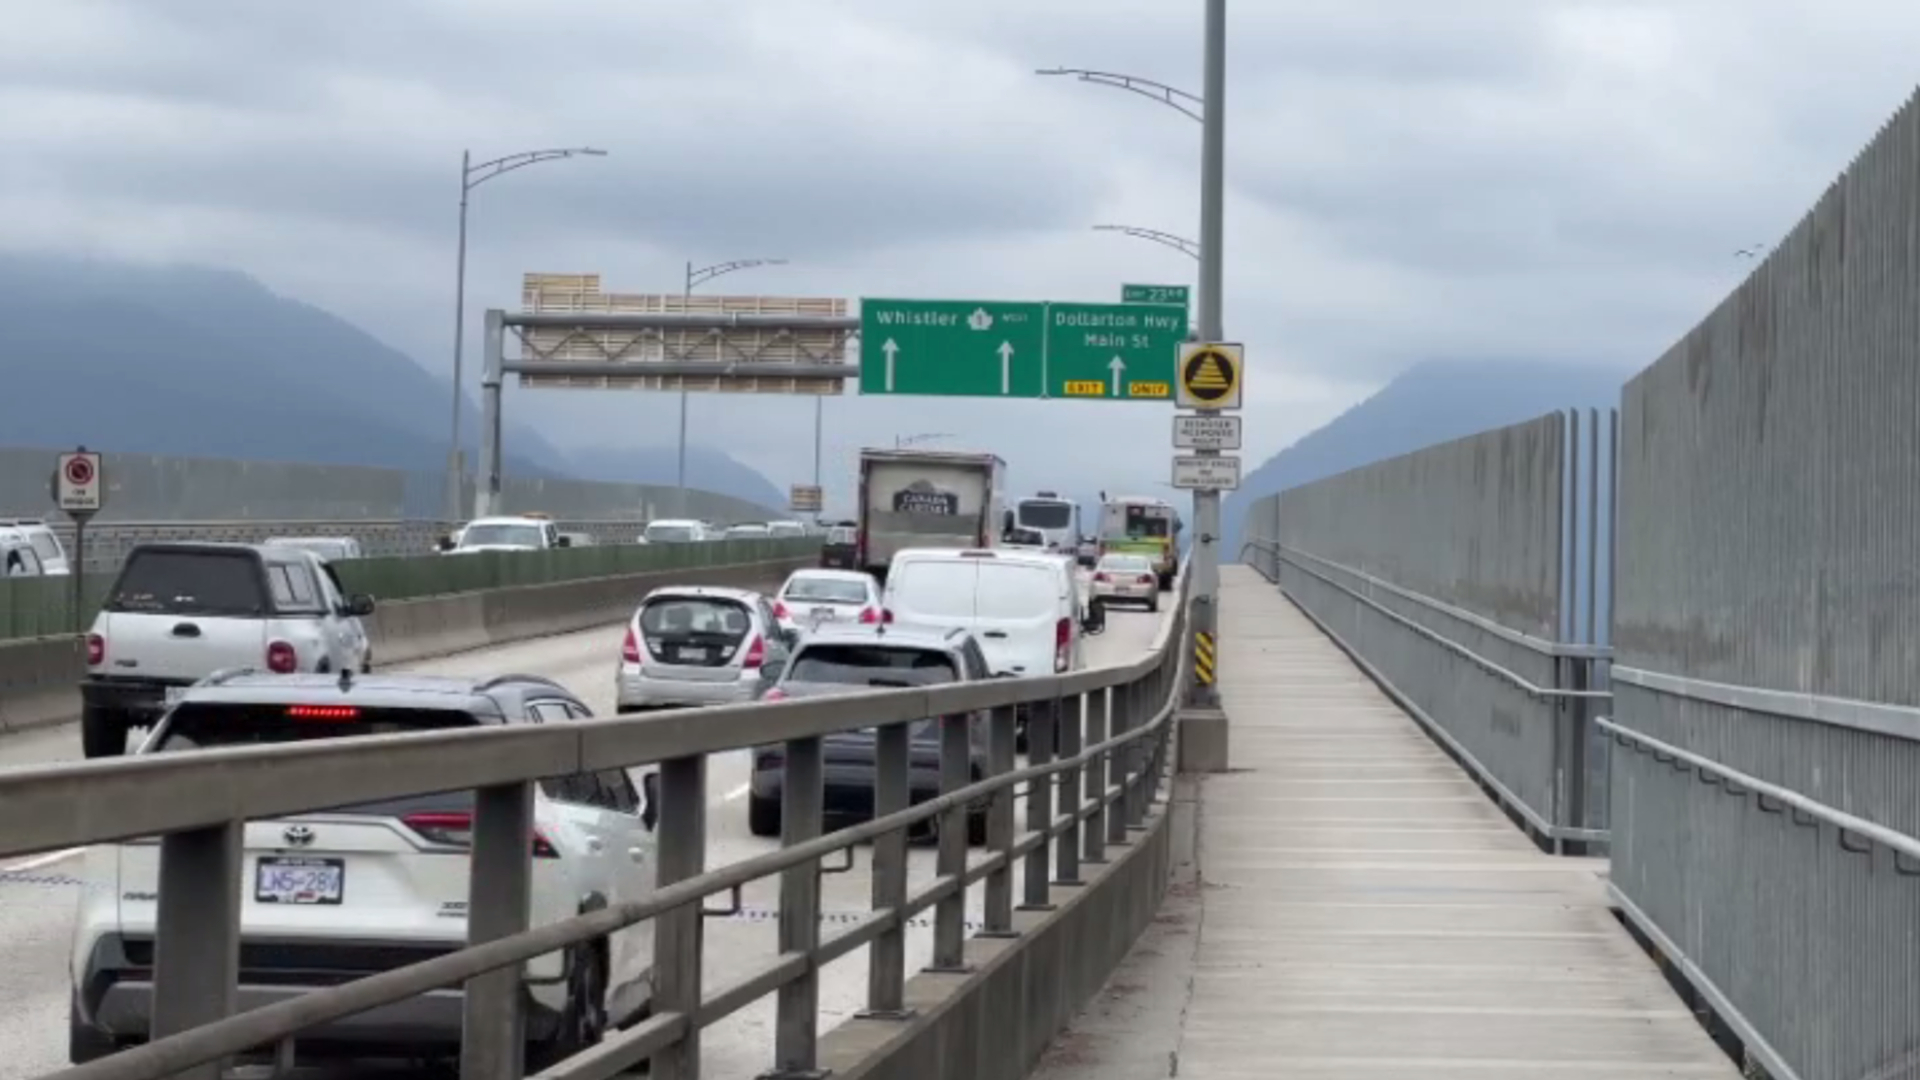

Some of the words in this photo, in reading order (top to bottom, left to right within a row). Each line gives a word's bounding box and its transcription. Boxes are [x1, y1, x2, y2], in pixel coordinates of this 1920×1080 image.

[876, 311, 958, 326] Whistler
[1056, 312, 1138, 326] Dollarton
[1145, 314, 1180, 332] Hwy
[1085, 333, 1124, 347] Main
[1131, 334, 1149, 348] St
[1066, 382, 1099, 394] EXIT
[1131, 384, 1165, 395] ONLY
